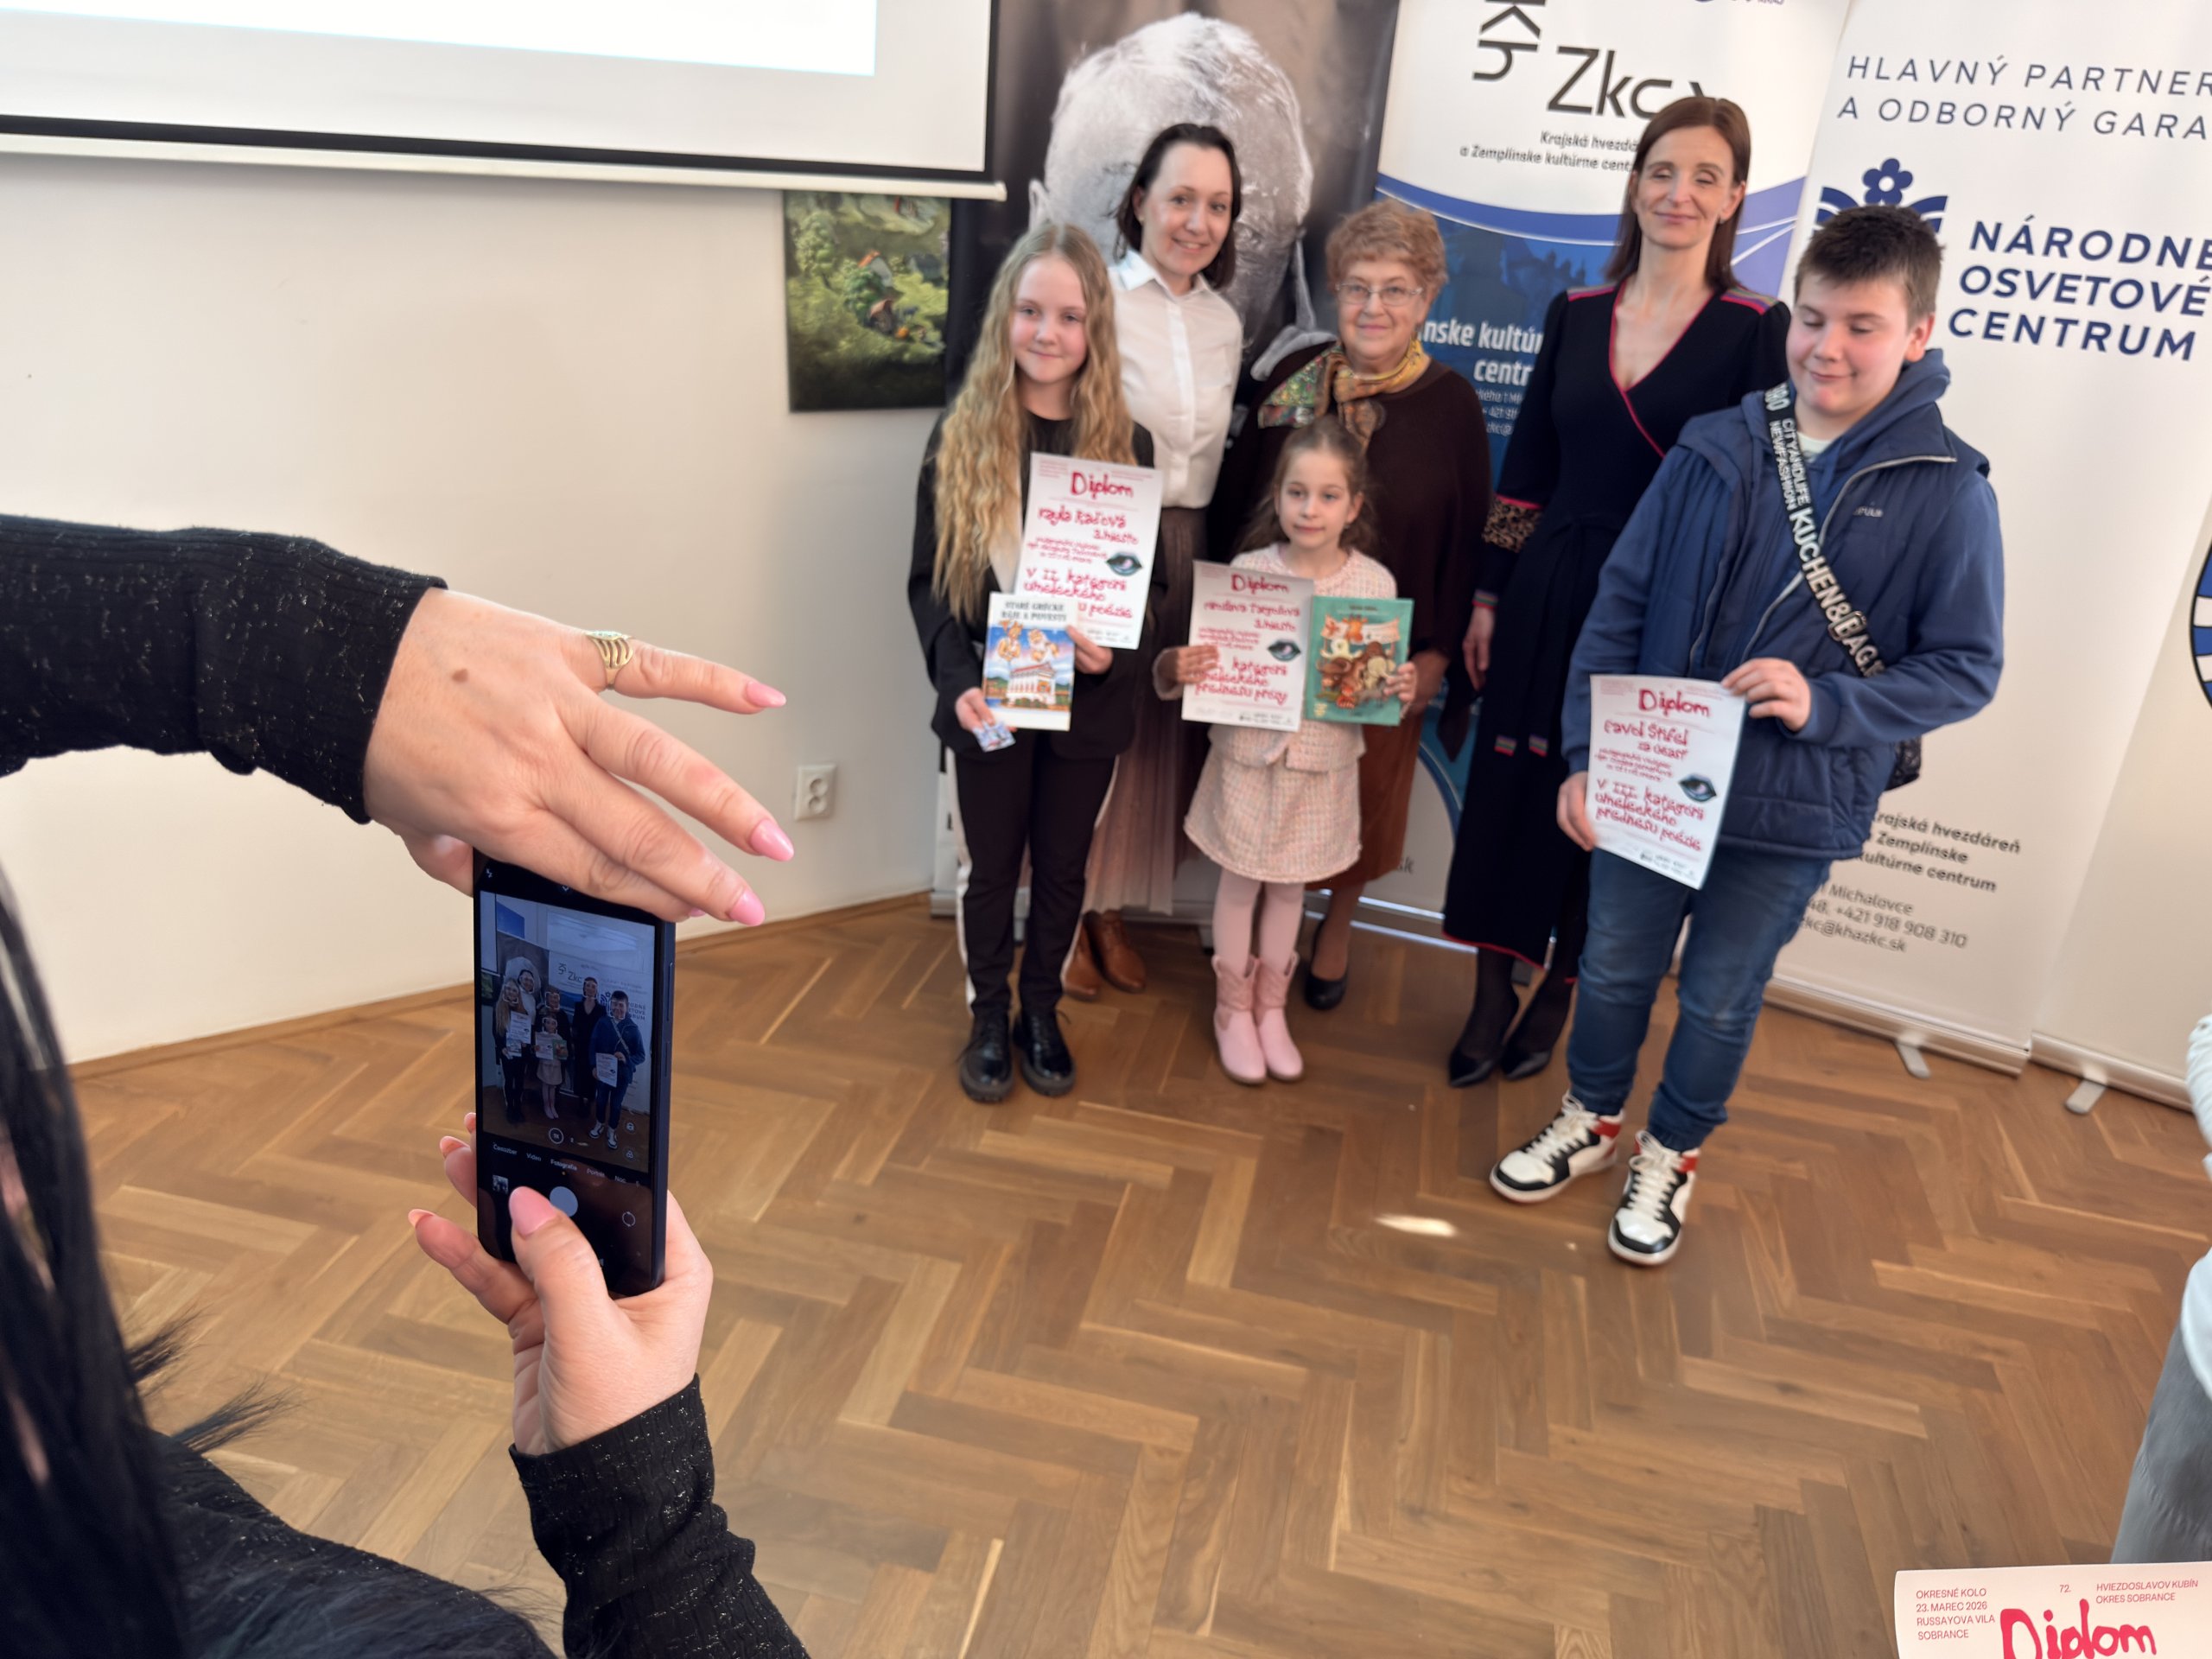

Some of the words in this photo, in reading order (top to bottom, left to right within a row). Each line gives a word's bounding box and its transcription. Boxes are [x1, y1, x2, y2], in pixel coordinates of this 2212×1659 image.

[1847, 54, 2008, 86] HLAVNÝ
[2024, 64, 2212, 97] PARTNER
[1837, 96, 1859, 119] A
[1878, 98, 2076, 131] ODBORNÝ
[2094, 111, 2207, 140] GARA
[1540, 130, 1589, 149] Krajská
[1459, 145, 1470, 156] a
[1471, 143, 1541, 164] Zemplínske
[1544, 150, 1599, 170] kultúrne
[1960, 264, 2211, 316] OSVETOVÉ
[1948, 308, 2196, 361] CENTRUM
[1071, 472, 1134, 499] Diplom
[1230, 573, 1290, 596] Diplom
[1637, 687, 1711, 718] Diplom
[1876, 830, 1969, 864] Zemplínske
[1931, 820, 2022, 855] hvezdáreň
[1927, 865, 1998, 893] centrum
[1828, 883, 1914, 914] Michalovce
[1873, 912, 1901, 932] 918
[1904, 918, 1936, 941] 908
[1938, 927, 1969, 950] 310
[1916, 1588, 1959, 1599] OKRESNÉ
[1961, 1587, 1987, 1598] KOLO
[2059, 1584, 2072, 1593] 72.
[2095, 1594, 2126, 1605] OKRES
[2126, 1592, 2177, 1604] SOBRANCE
[2096, 1580, 2171, 1592] HVIEZDOSLAVOV
[2171, 1579, 2199, 1589] KUBÍN
[1916, 1603, 1929, 1612] 23.
[1930, 1602, 1963, 1612] MAREC
[1964, 1601, 1988, 1611] 2026
[1916, 1615, 1974, 1627] RUSSAYOVA
[1975, 1614, 1996, 1624] VILA
[2000, 1599, 2157, 1659] Diplom
[1917, 1629, 1970, 1641] SOBRANCE
